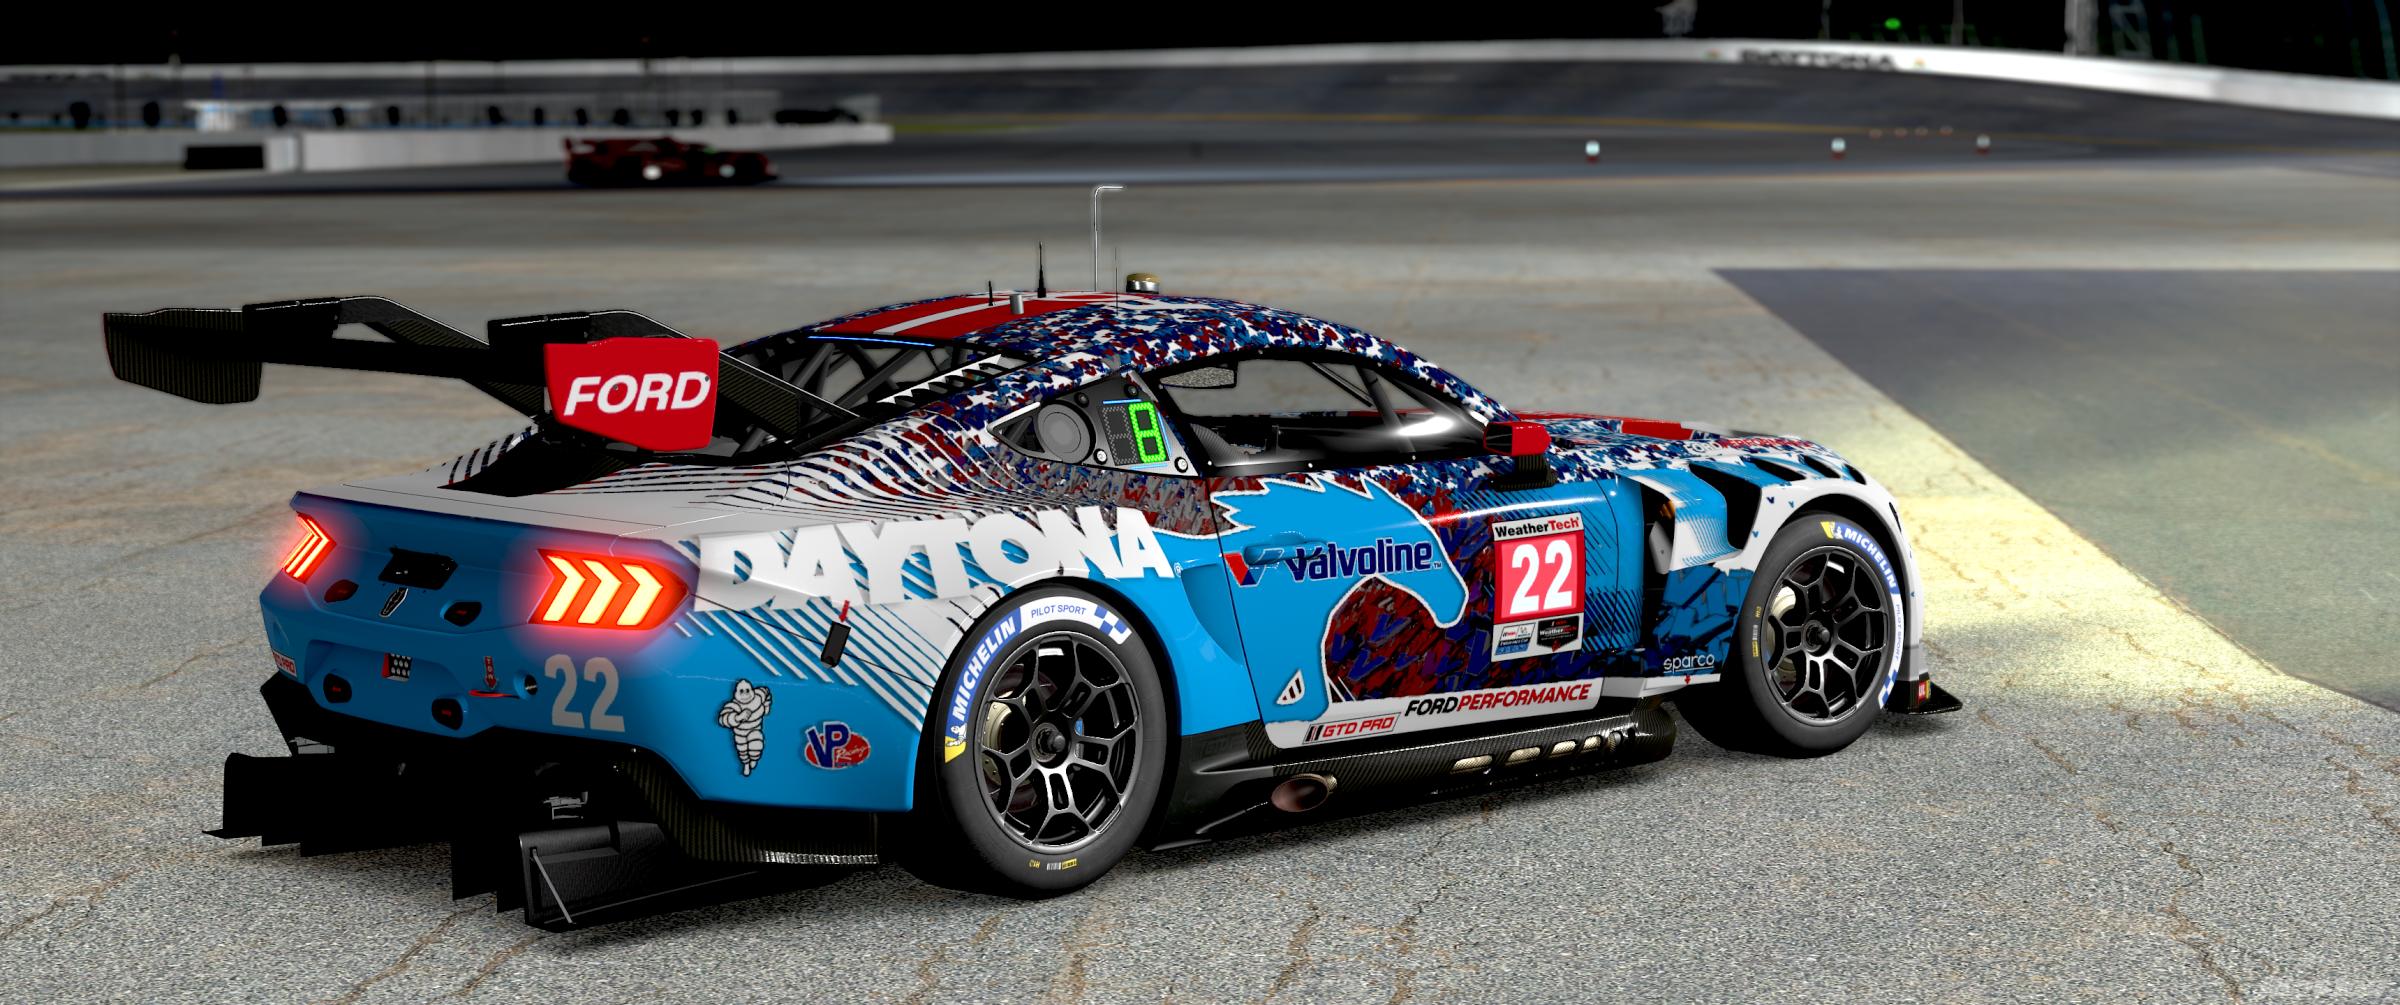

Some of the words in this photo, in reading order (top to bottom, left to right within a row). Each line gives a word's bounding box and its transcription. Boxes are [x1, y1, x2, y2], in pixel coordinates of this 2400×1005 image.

[563, 371, 712, 417] FORD
[1495, 517, 1579, 538] WeatherTech
[697, 506, 1175, 611] DAYTONA
[1285, 537, 1433, 583] Valvoline
[1509, 539, 1573, 615] 22
[1844, 527, 1897, 588] MICHELIN
[1030, 606, 1055, 619] PILOT
[1057, 604, 1087, 616] SPORT
[952, 615, 1016, 722] MICHELIN
[1663, 653, 1715, 675] sparco
[544, 653, 626, 733] 22
[806, 722, 851, 767] VP
[1322, 721, 1358, 738] GTD
[1359, 715, 1396, 734] PRO
